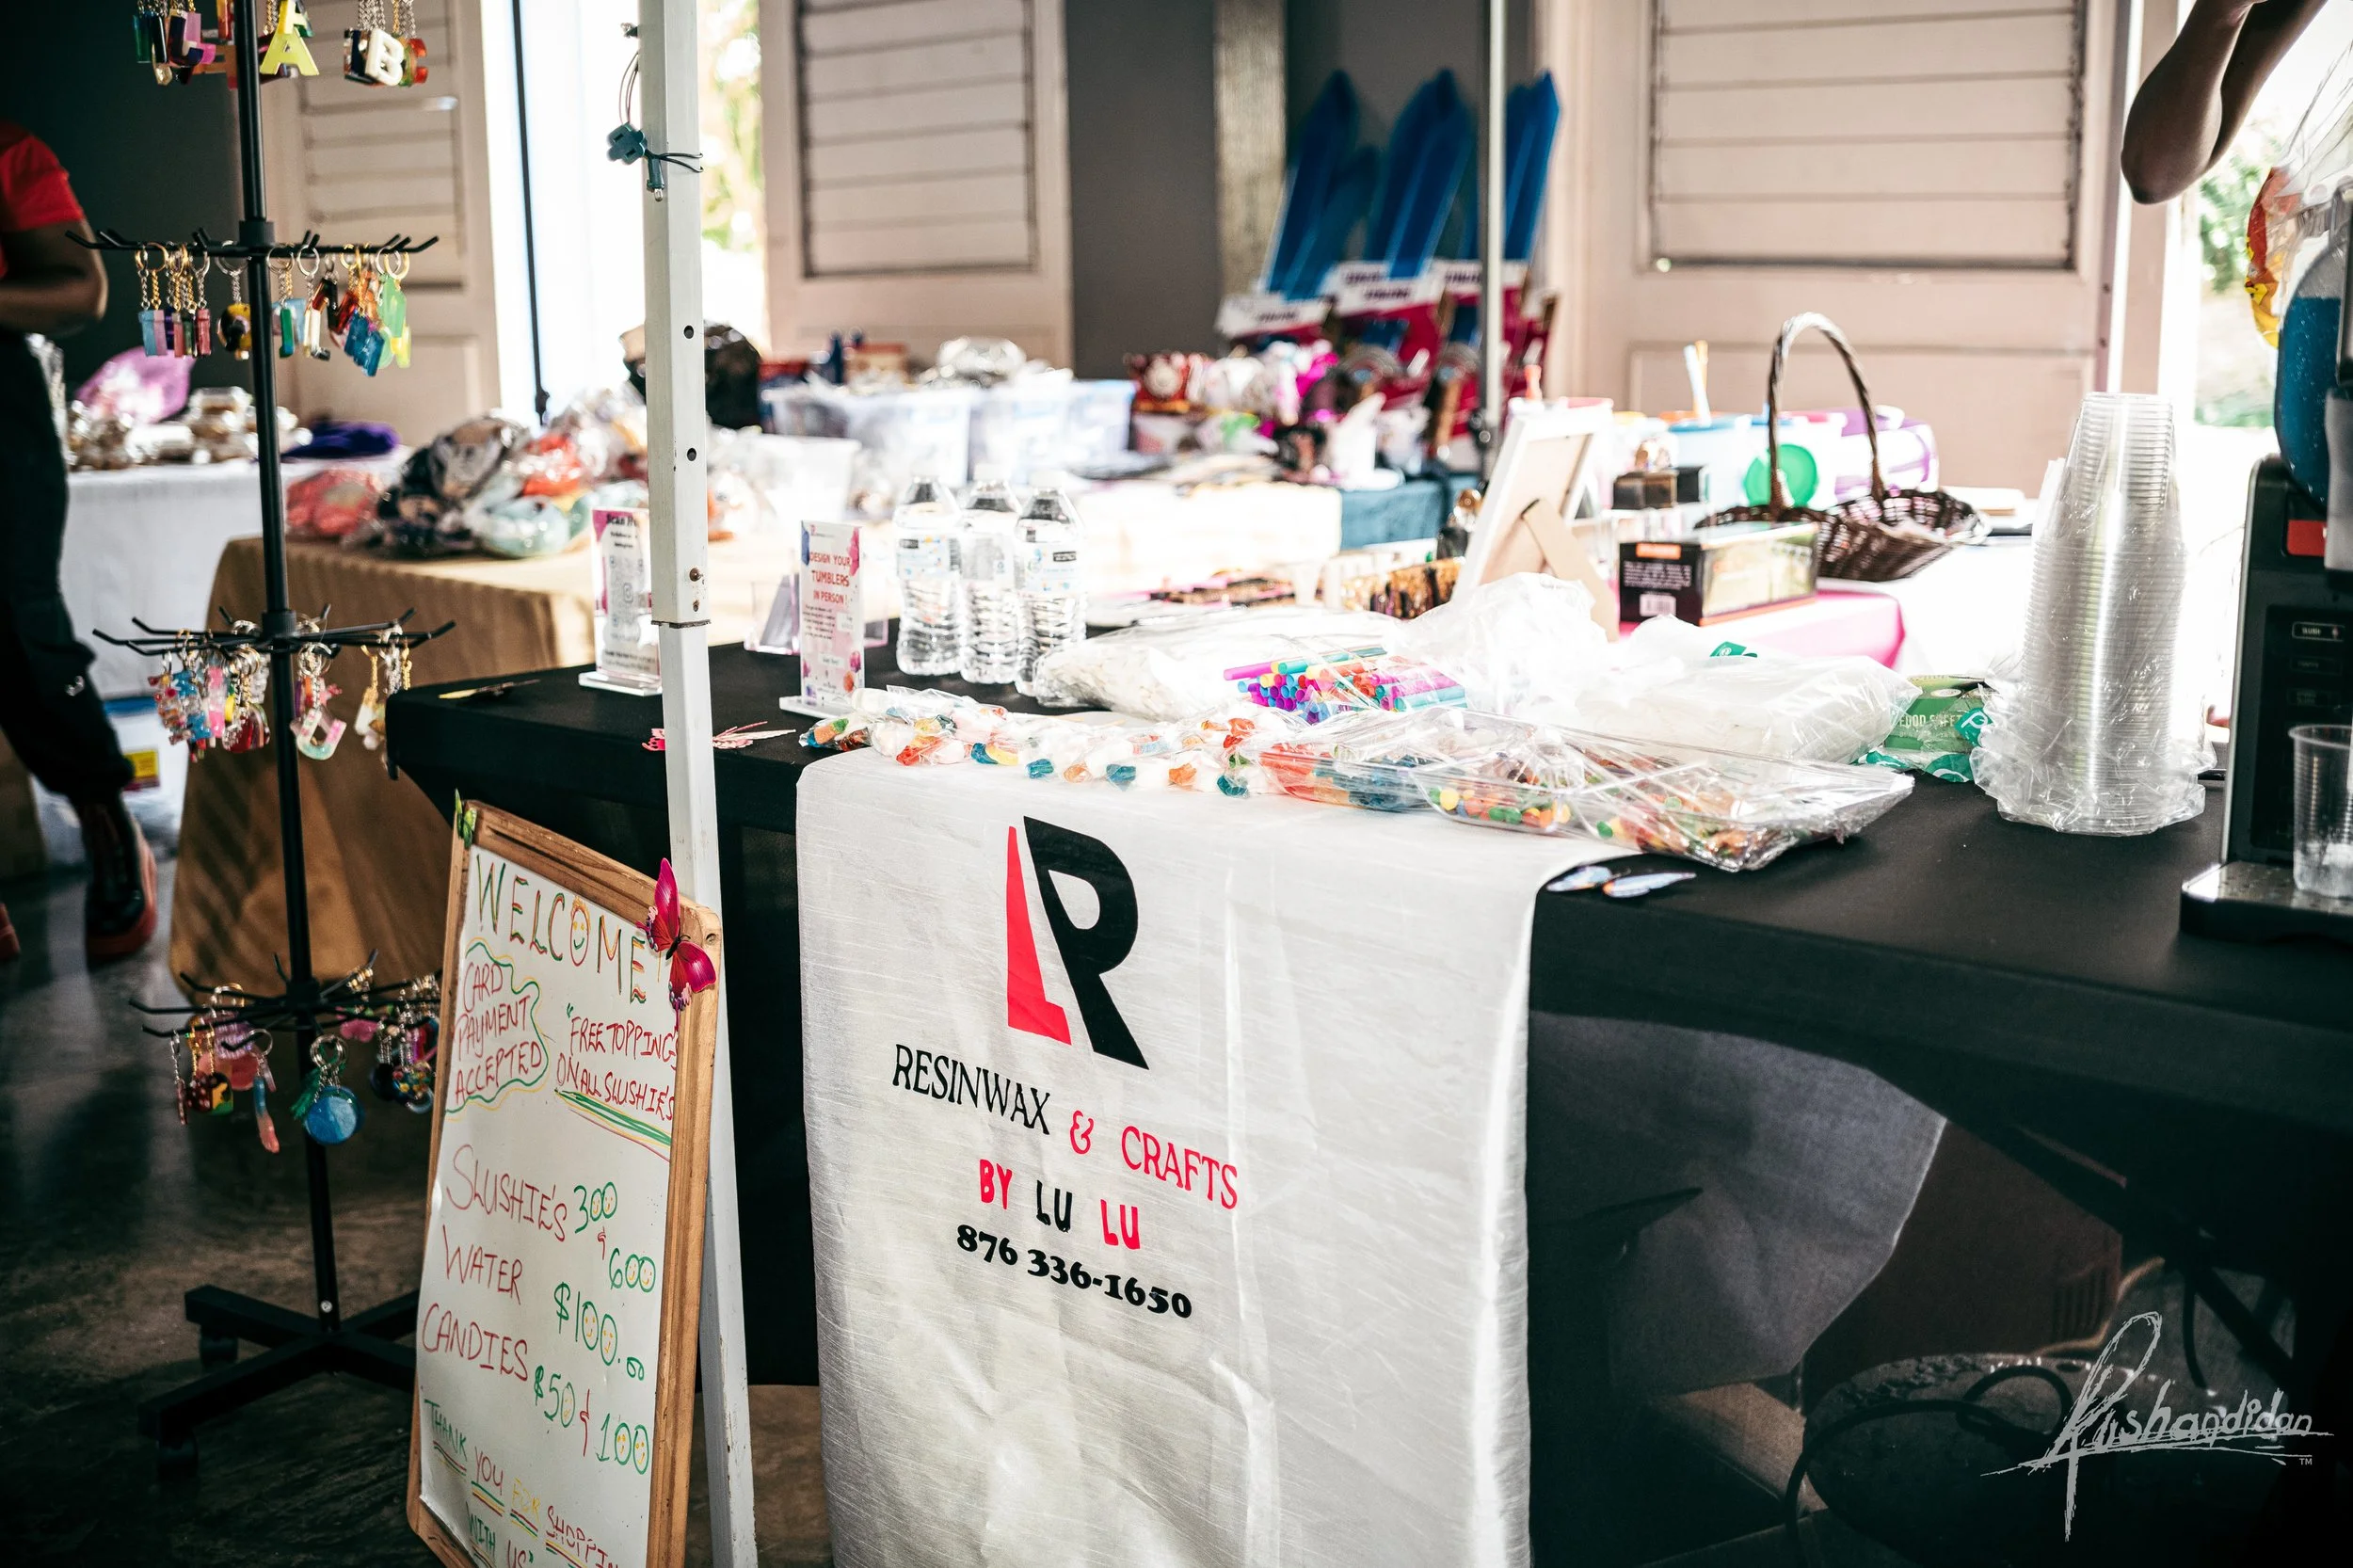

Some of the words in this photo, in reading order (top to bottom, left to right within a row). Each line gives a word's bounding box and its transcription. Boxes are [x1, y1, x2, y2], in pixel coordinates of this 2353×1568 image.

[809, 552, 830, 564] DESIGN
[834, 555, 851, 568] YOUR
[811, 569, 850, 587] TUMBLERS
[813, 590, 820, 600] IN
[475, 854, 647, 1004] WELCOME
[463, 961, 504, 1014] CARD
[455, 995, 531, 1062] PAYMENT
[456, 1041, 542, 1105] ACCEPTED
[557, 1052, 580, 1090] ON
[580, 1068, 602, 1097] ALL
[892, 1043, 1051, 1136] RESINWAX
[1069, 1111, 1095, 1155] &
[1121, 1126, 1240, 1210] CRAFTS
[573, 1181, 617, 1234] 300
[979, 1159, 1013, 1210] BY
[1035, 1180, 1073, 1233] LU
[1099, 1198, 1142, 1251] LU
[442, 1224, 523, 1305] WATER
[609, 1247, 656, 1293] 600
[956, 1224, 1018, 1267] 876
[1027, 1248, 1193, 1319] 336-1650
[422, 1303, 529, 1382] CANDIES
[534, 1365, 575, 1428] $50
[596, 1413, 649, 1475] 100
[424, 1399, 468, 1462] THANK
[474, 1446, 504, 1496] YOU
[511, 1477, 541, 1527] FOR
[546, 1505, 618, 1568] SHOPPI
[466, 1501, 496, 1558] WITH
